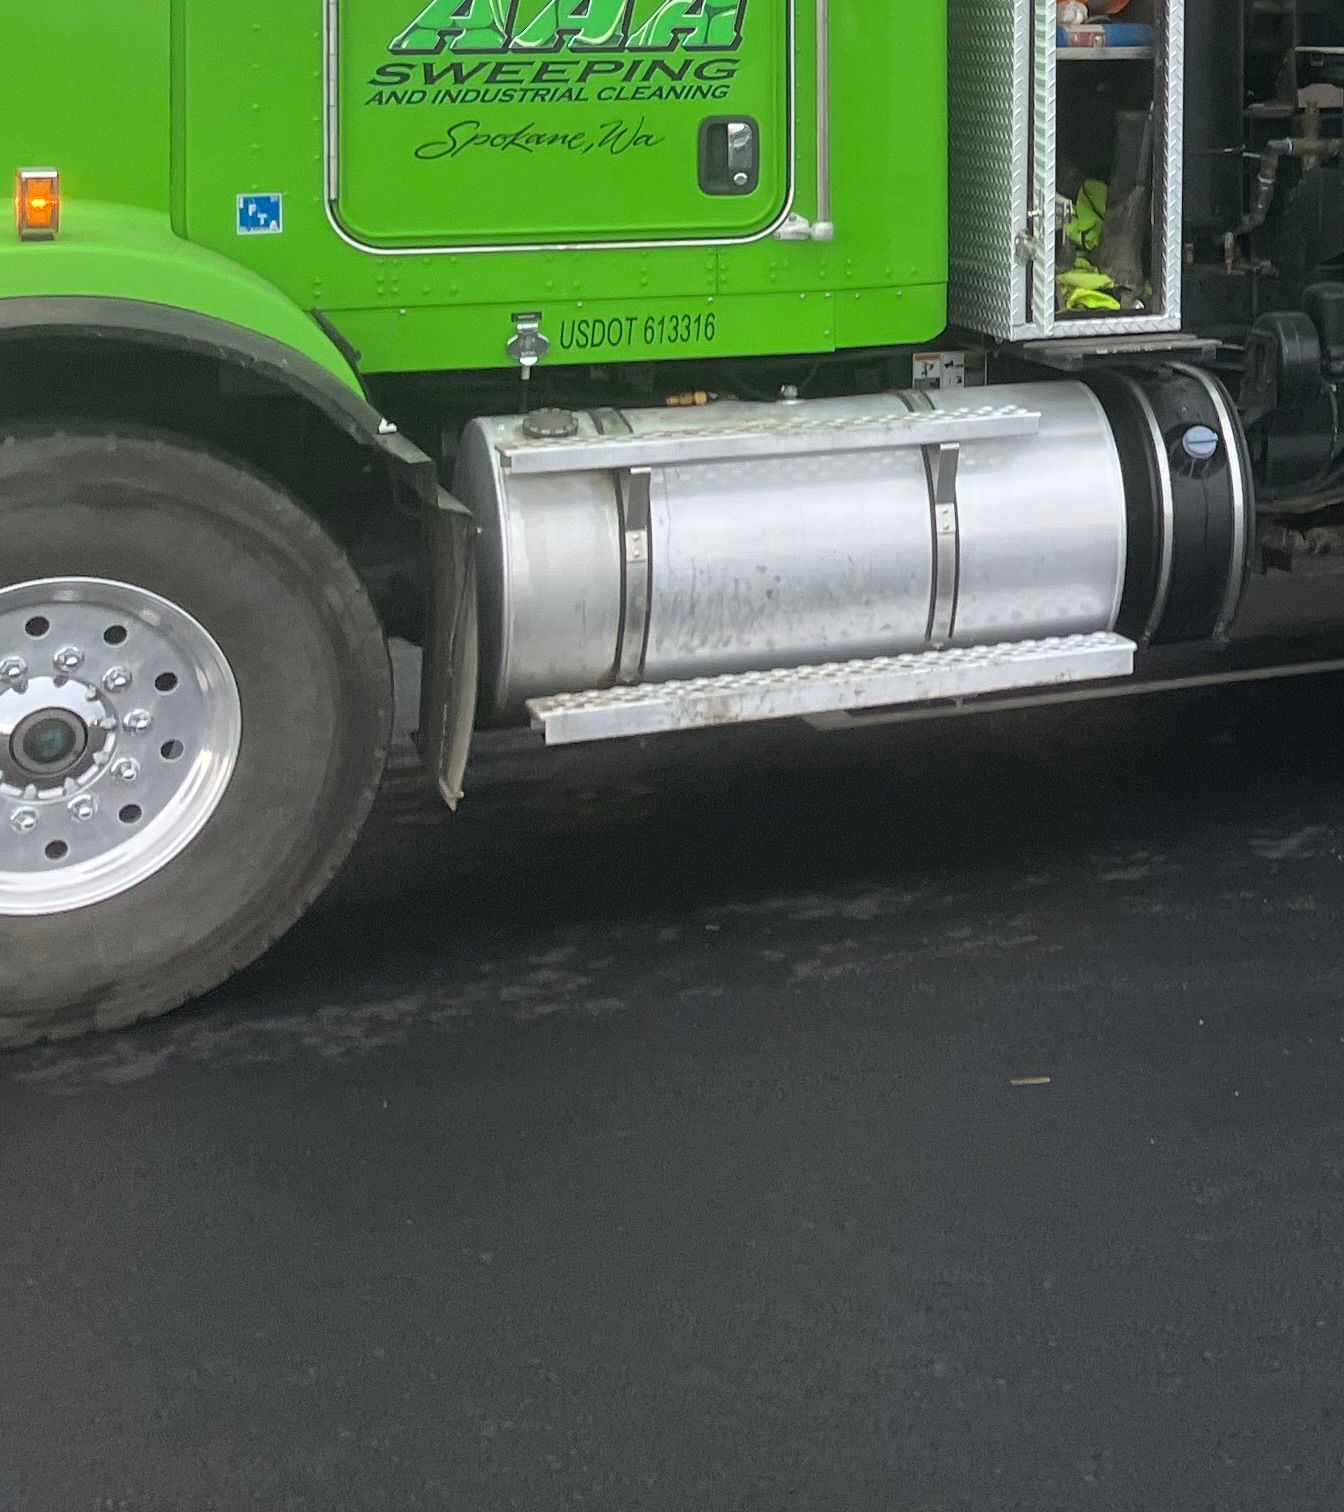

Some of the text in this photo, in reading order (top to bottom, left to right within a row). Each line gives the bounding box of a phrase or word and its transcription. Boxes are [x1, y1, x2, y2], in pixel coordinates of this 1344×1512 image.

[367, 57, 742, 88] SWEEPING
[364, 84, 731, 106] AND INDUSTRIAL CLEANING
[559, 312, 716, 350] USDOT 613316
